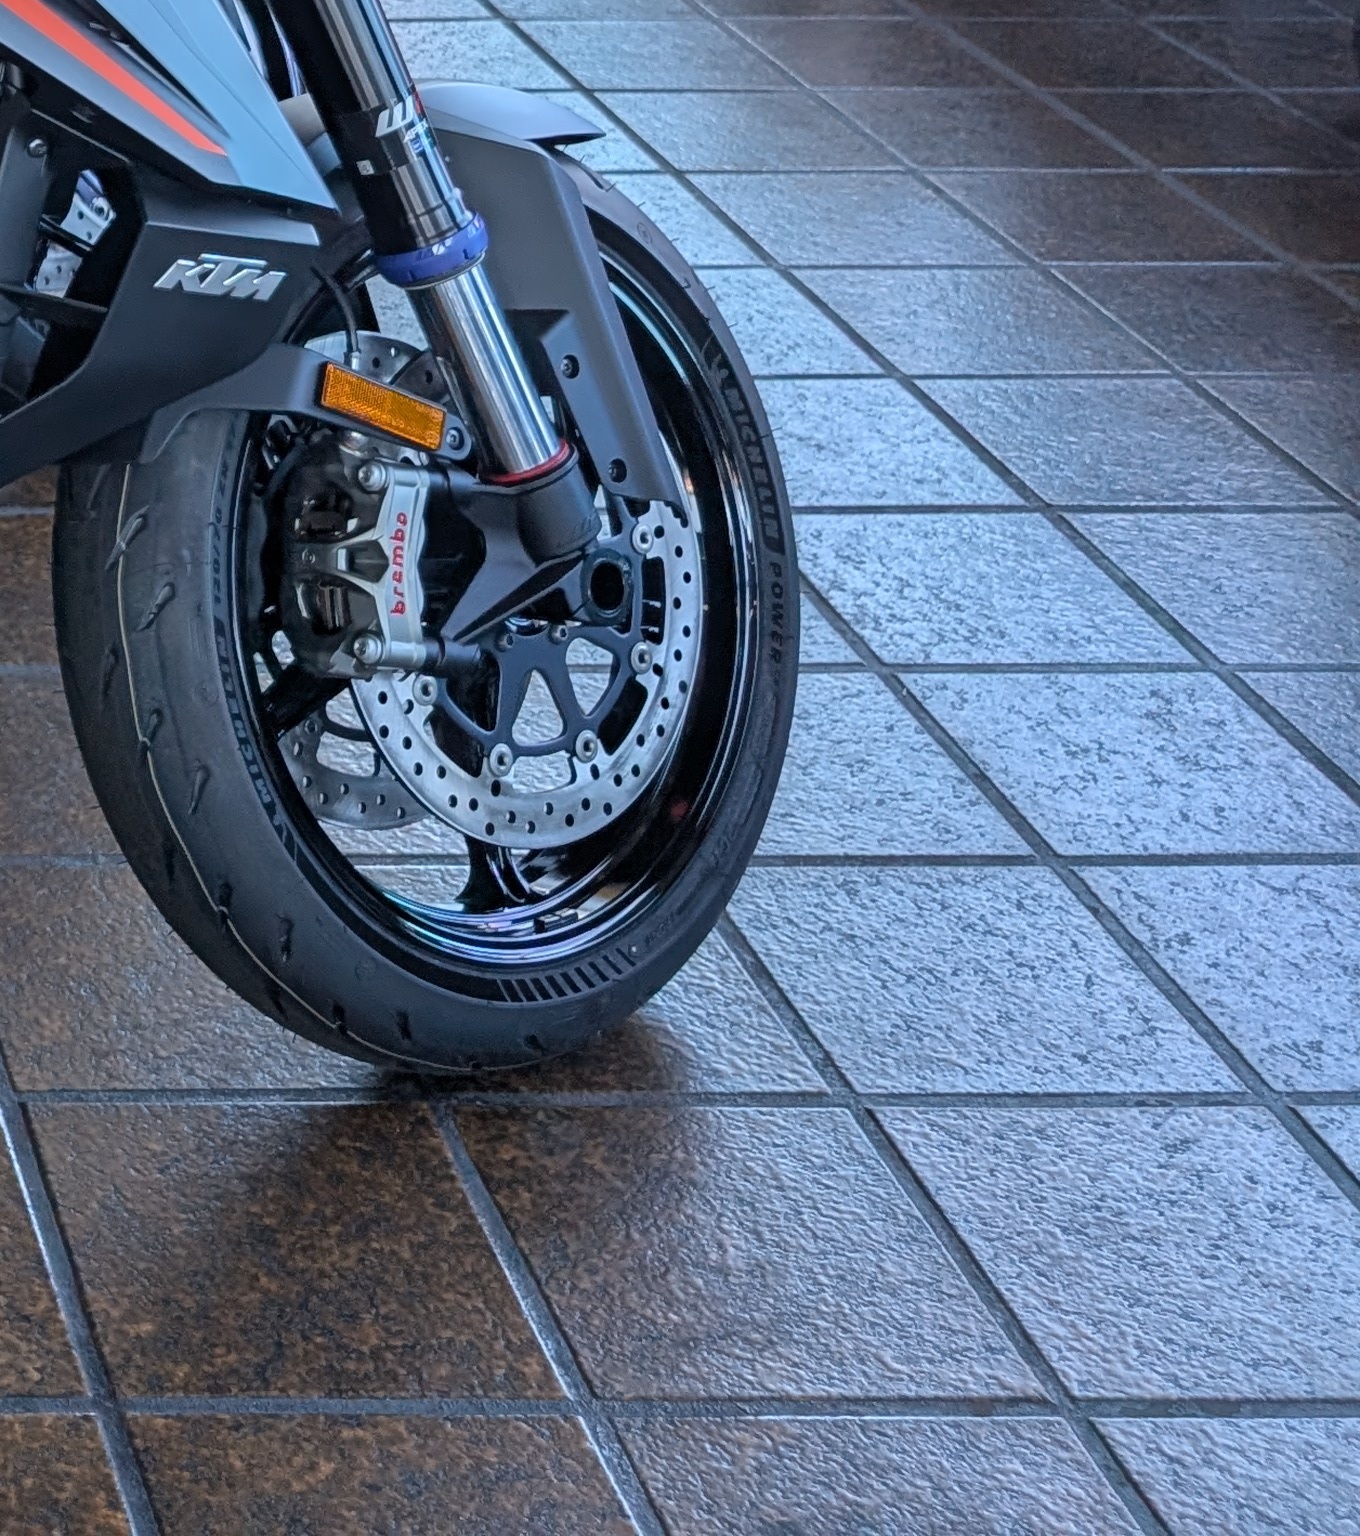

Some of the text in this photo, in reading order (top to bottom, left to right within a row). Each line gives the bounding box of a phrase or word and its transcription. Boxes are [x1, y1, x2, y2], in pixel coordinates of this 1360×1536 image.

[152, 252, 288, 302] KTM
[390, 512, 407, 615] brembo
[724, 384, 785, 662] MICHELIN POWER
[216, 632, 273, 805] MICHELIN
